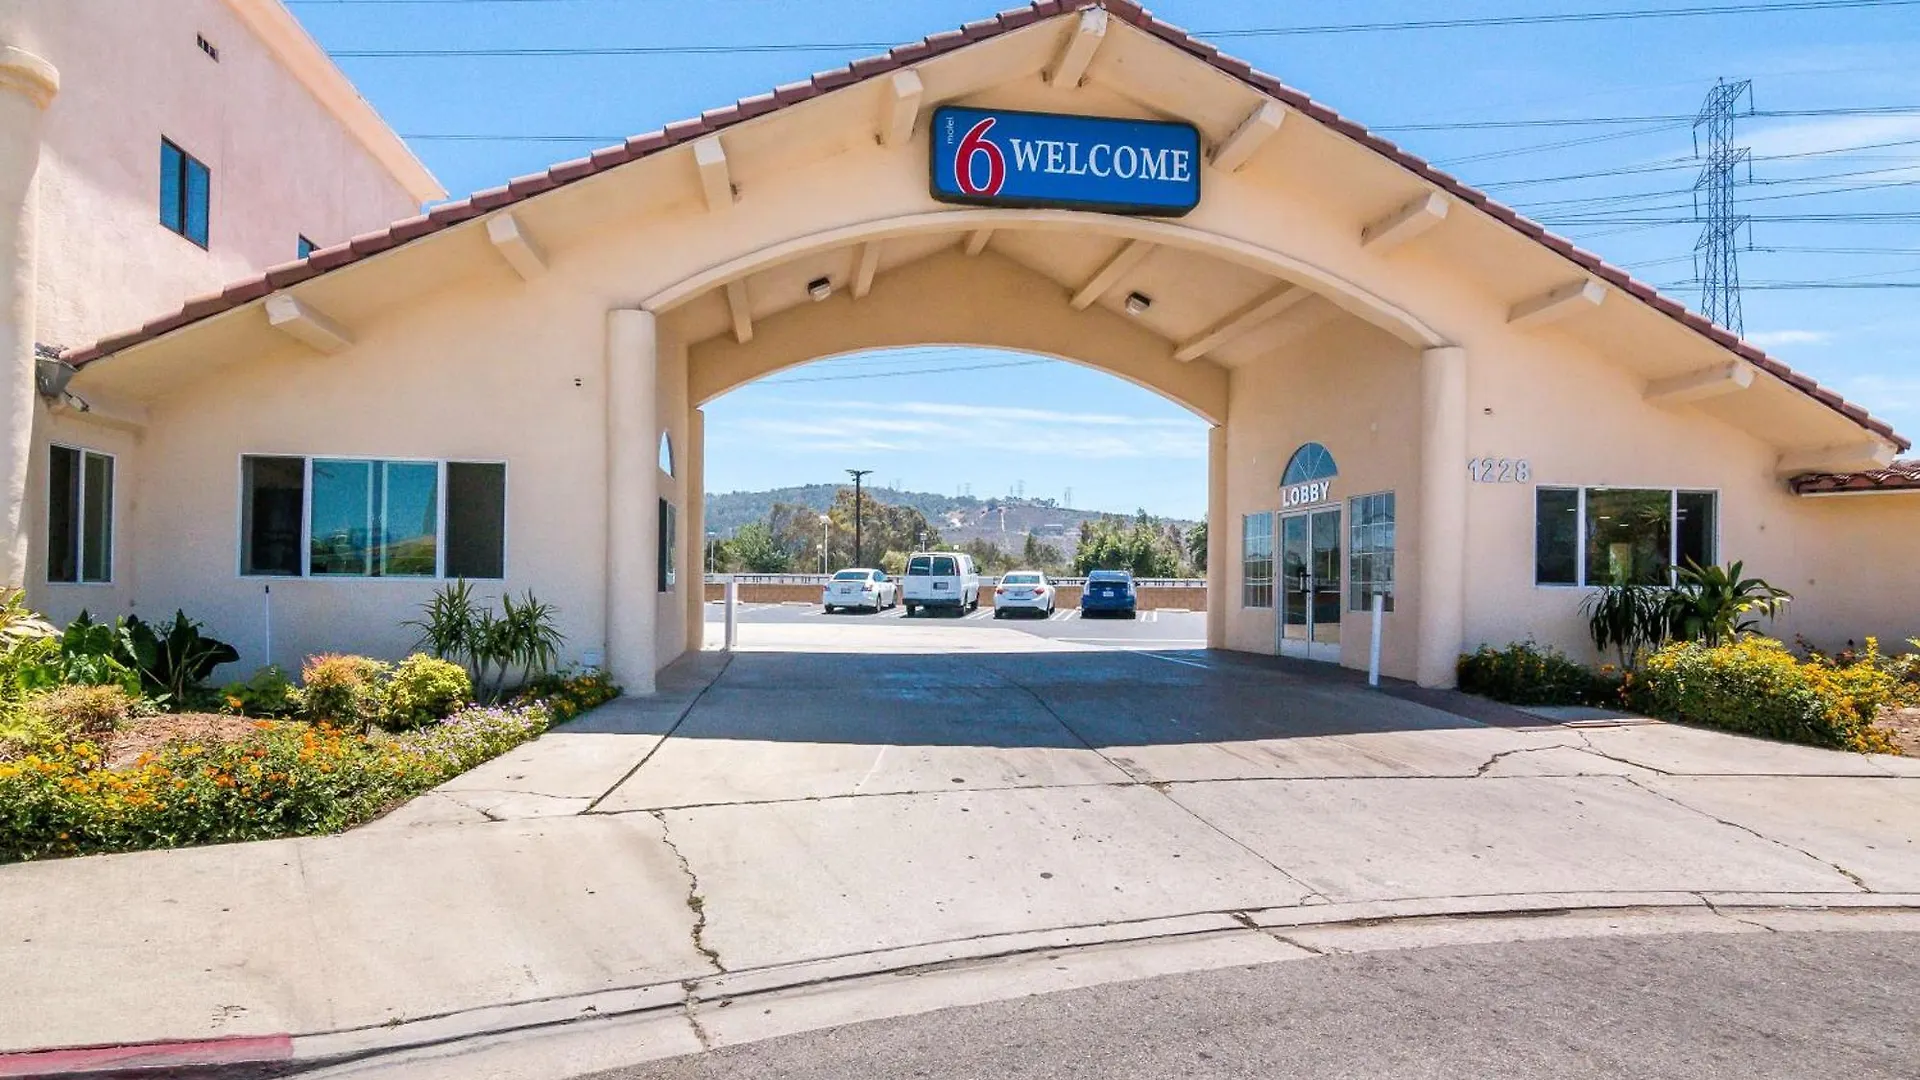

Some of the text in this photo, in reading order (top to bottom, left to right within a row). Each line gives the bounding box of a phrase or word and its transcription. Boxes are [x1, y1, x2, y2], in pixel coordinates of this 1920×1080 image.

[945, 116, 1006, 196] motel 6
[1009, 138, 1191, 182] WELCOME
[1467, 457, 1531, 484] 1228
[1282, 481, 1331, 507] LOBBY
